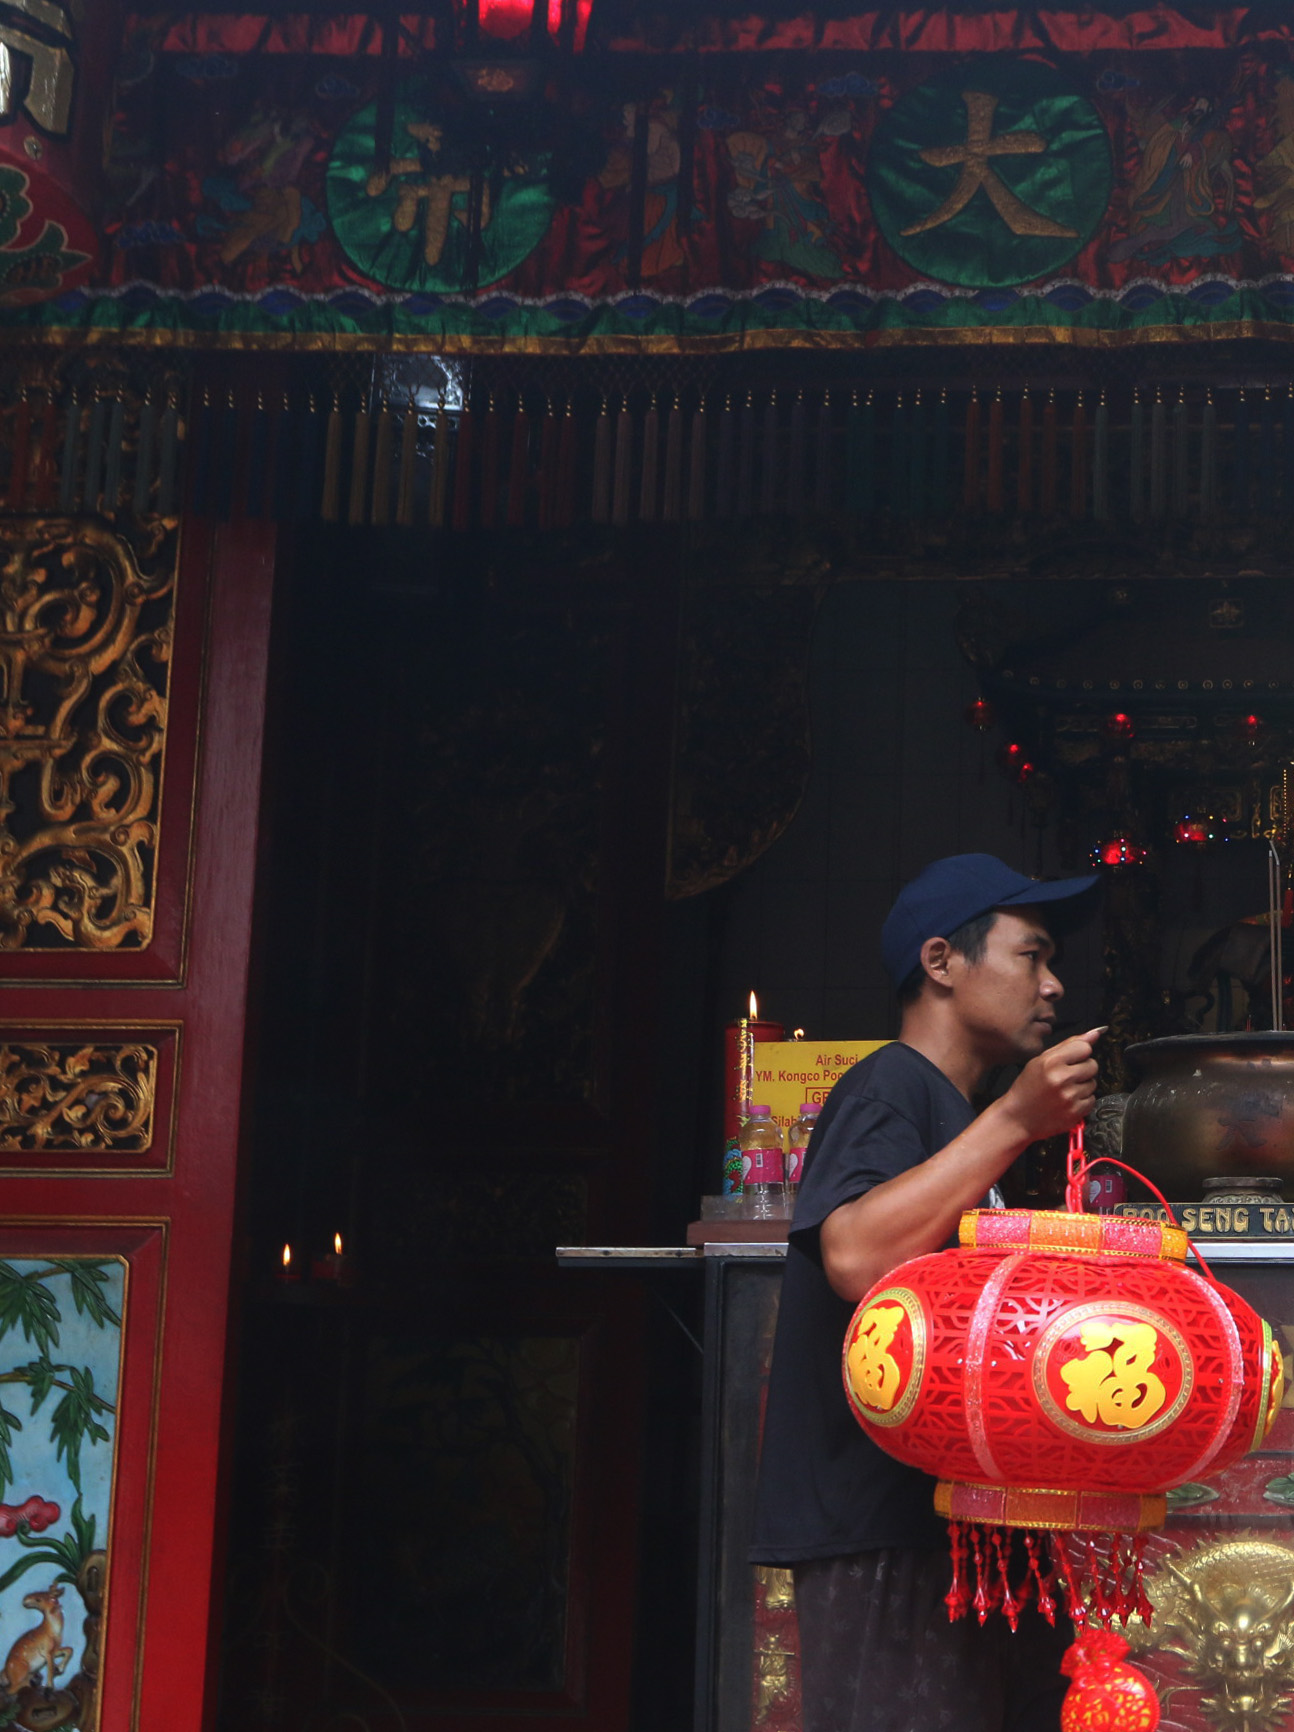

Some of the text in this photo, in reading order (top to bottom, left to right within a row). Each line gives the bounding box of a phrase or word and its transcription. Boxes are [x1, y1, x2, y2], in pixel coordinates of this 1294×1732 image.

[900, 90, 1080, 239] 大
[815, 1053, 859, 1066] Air Suci
[755, 1070, 775, 1082] YM.
[778, 1070, 820, 1084] Kongco
[1182, 1207, 1249, 1233] SENG
[1059, 1321, 1167, 1429] 福
